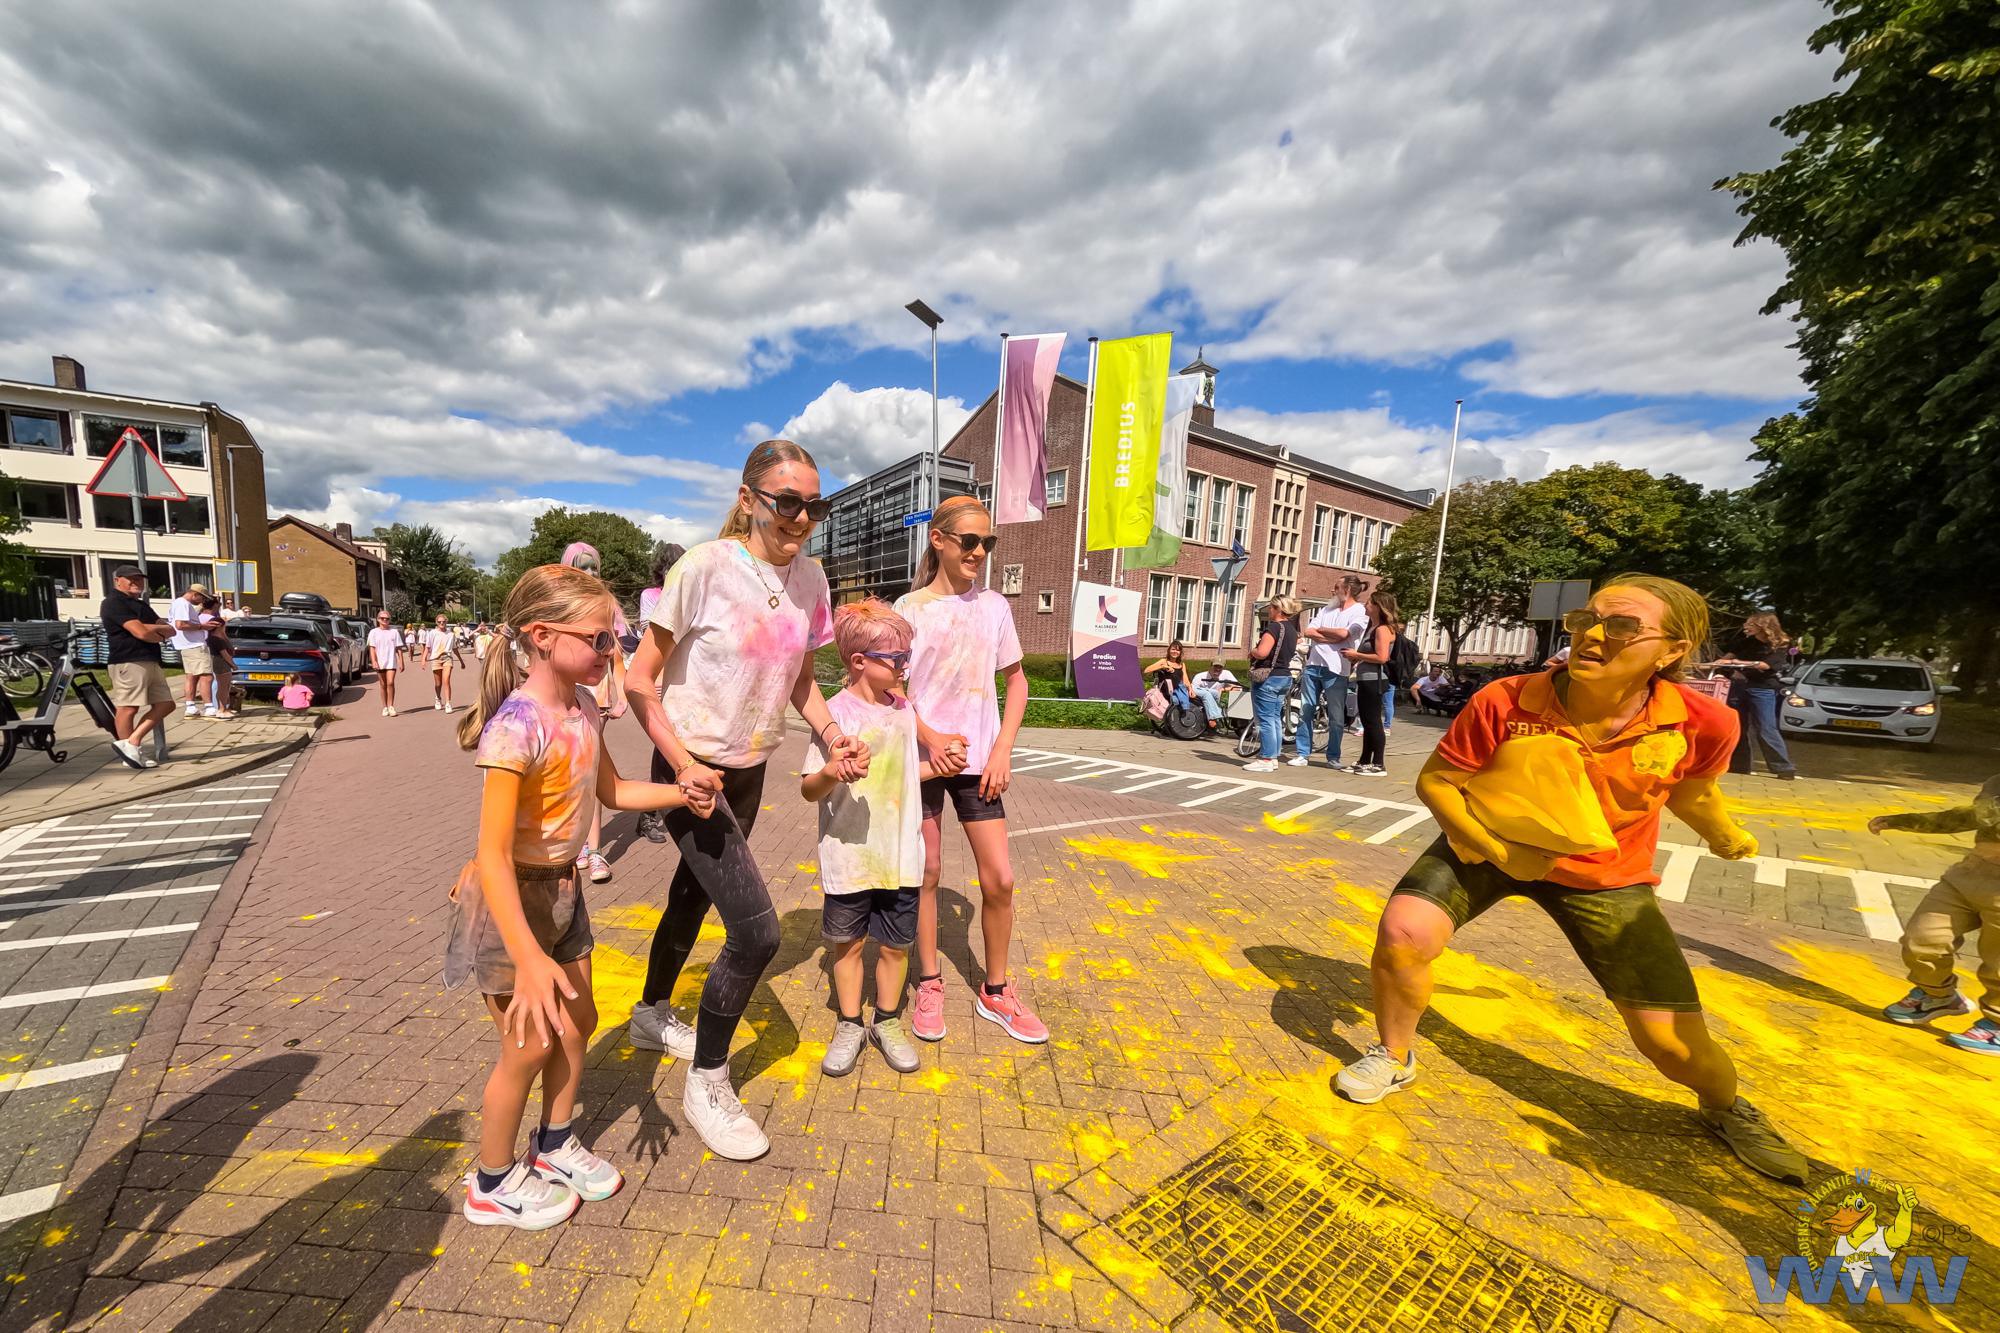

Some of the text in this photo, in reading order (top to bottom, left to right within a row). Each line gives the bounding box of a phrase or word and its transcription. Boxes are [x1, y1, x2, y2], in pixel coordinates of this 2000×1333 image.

[1114, 402, 1136, 488] BREDIUS
[1092, 653, 1117, 661] Bredius
[1506, 721, 1559, 736] CREW
